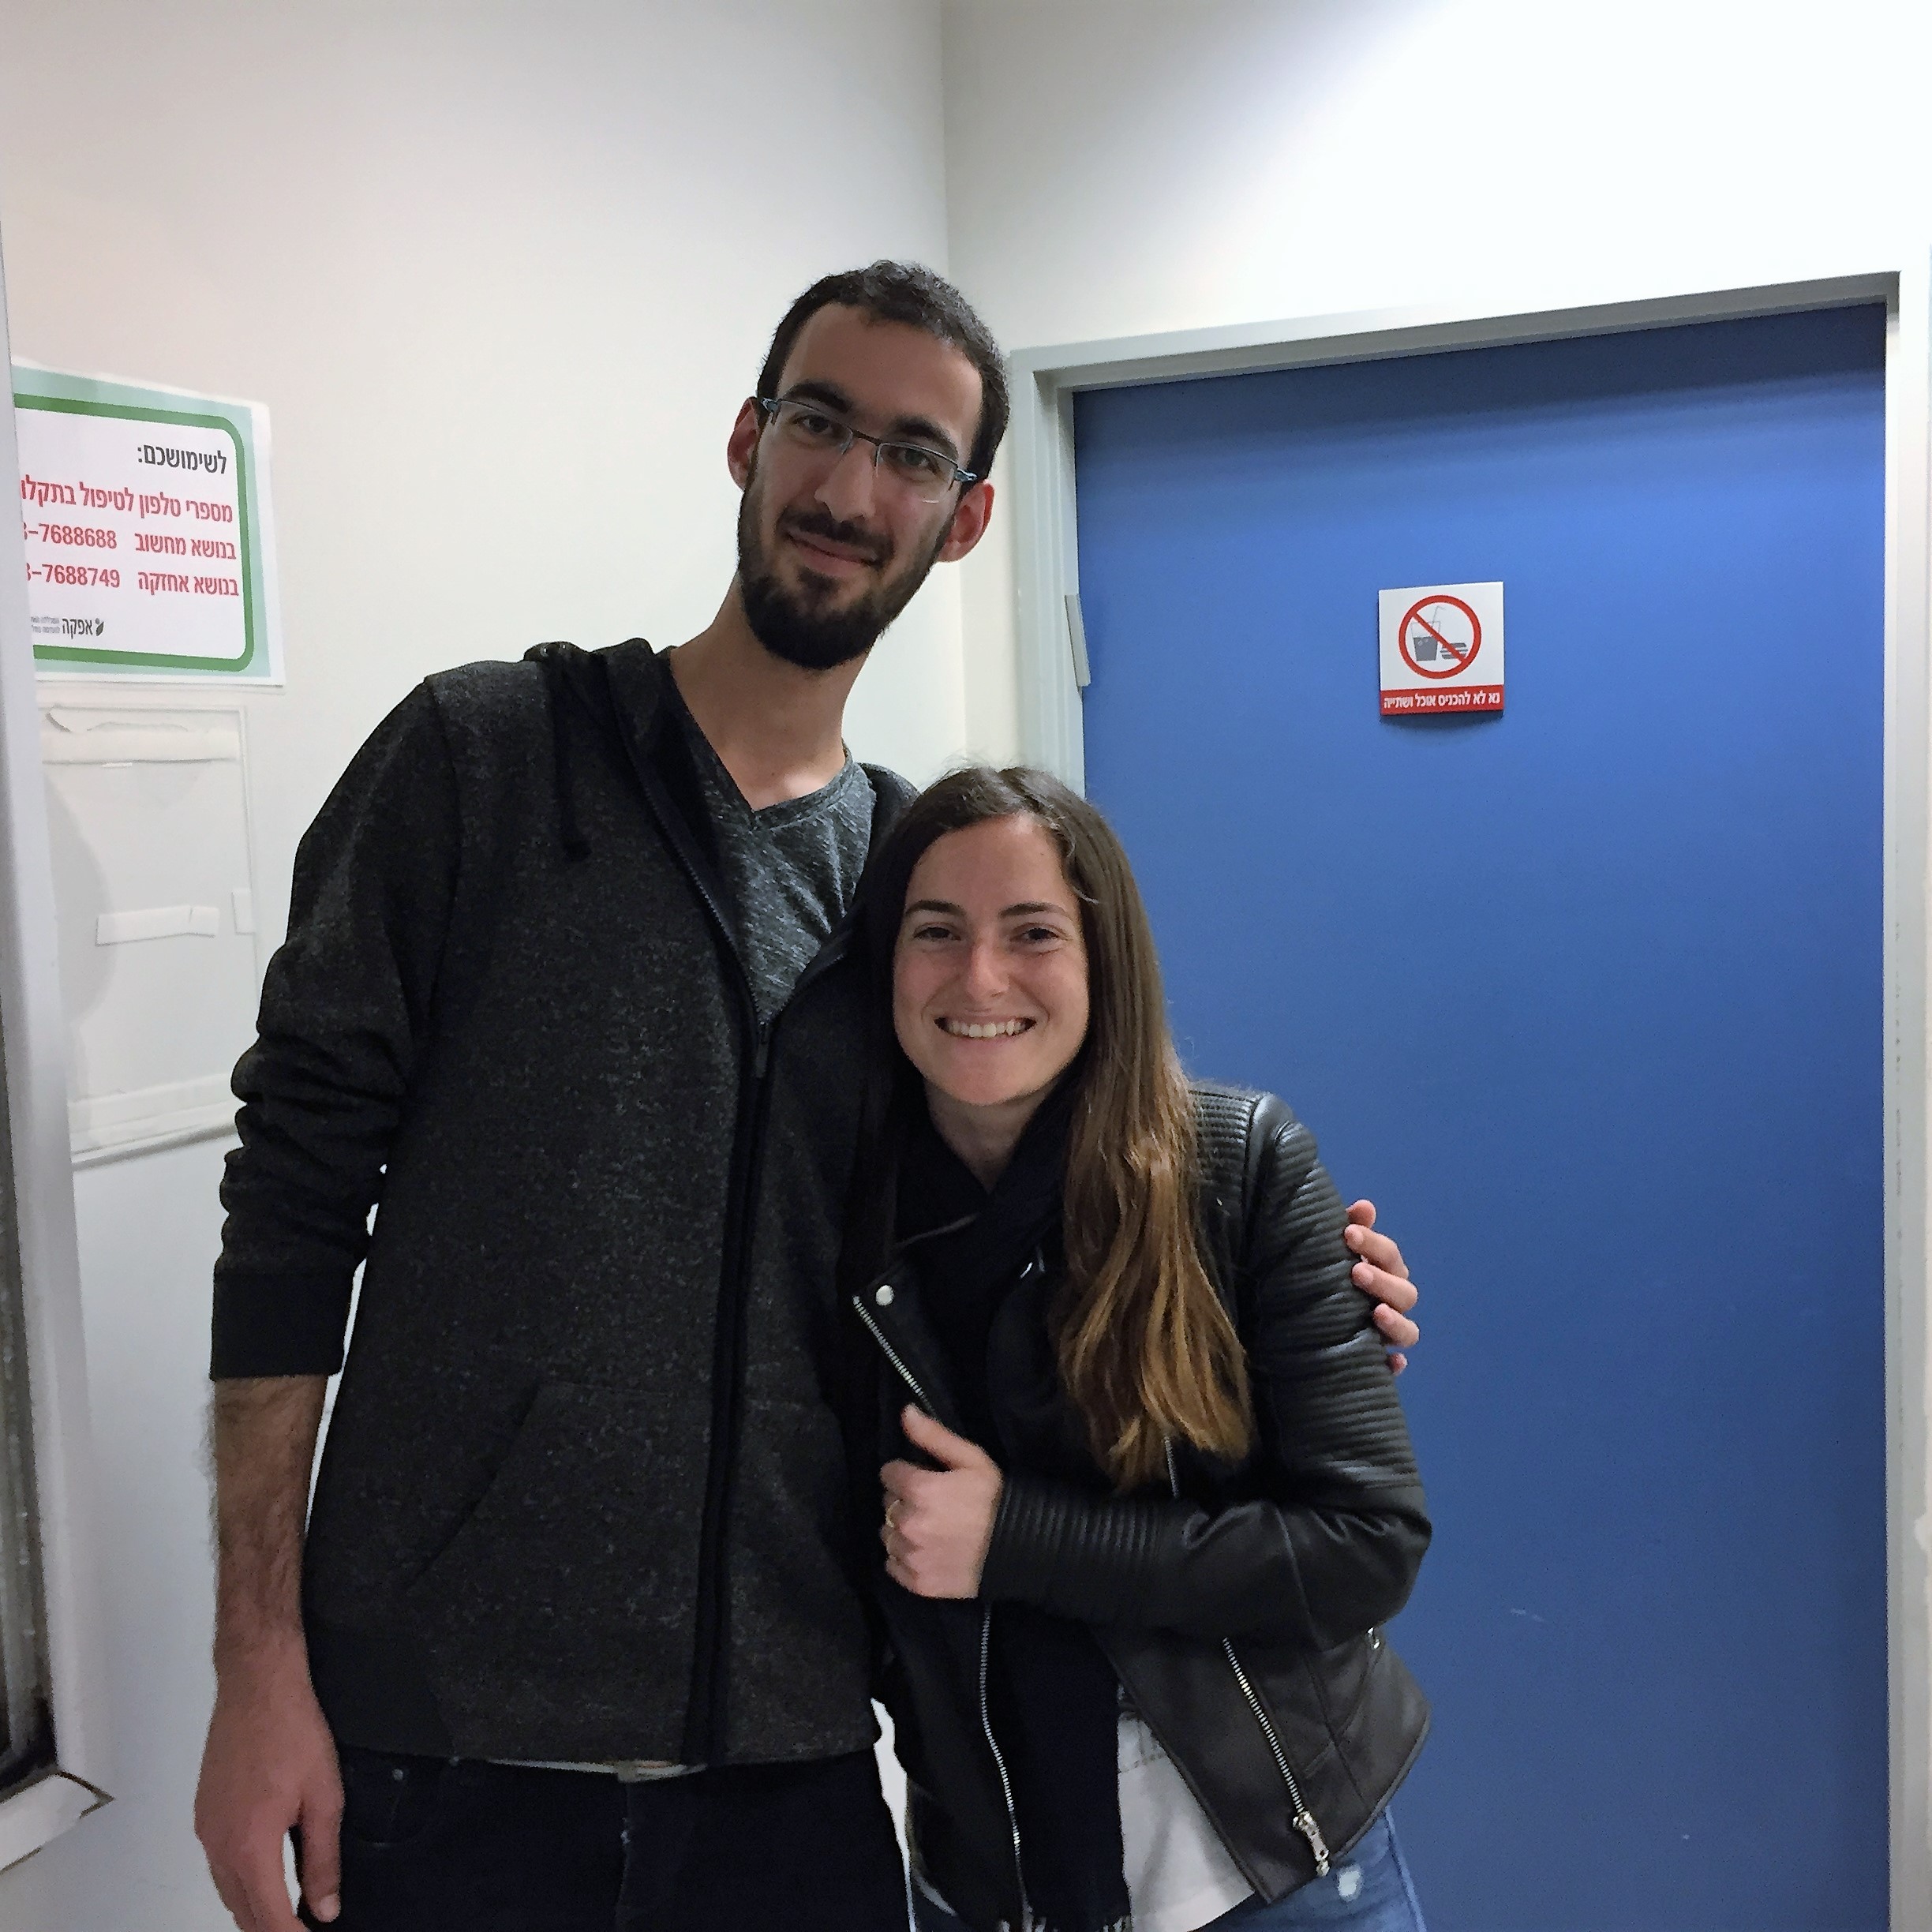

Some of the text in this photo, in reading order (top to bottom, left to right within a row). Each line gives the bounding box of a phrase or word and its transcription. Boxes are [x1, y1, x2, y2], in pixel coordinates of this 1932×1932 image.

[137, 444, 227, 474] לשימושכם:
[78, 481, 134, 512] לטיפול
[138, 491, 182, 519] טלפון
[185, 500, 233, 523] מספרי
[133, 533, 187, 556] מחשוב
[190, 538, 237, 560] בנושא
[137, 571, 190, 596] אחזקה
[193, 575, 240, 597] בנושא
[62, 618, 93, 640] אפקה
[1437, 691, 1471, 706] להכניס
[1473, 690, 1487, 705] לא
[1488, 692, 1501, 704] נא
